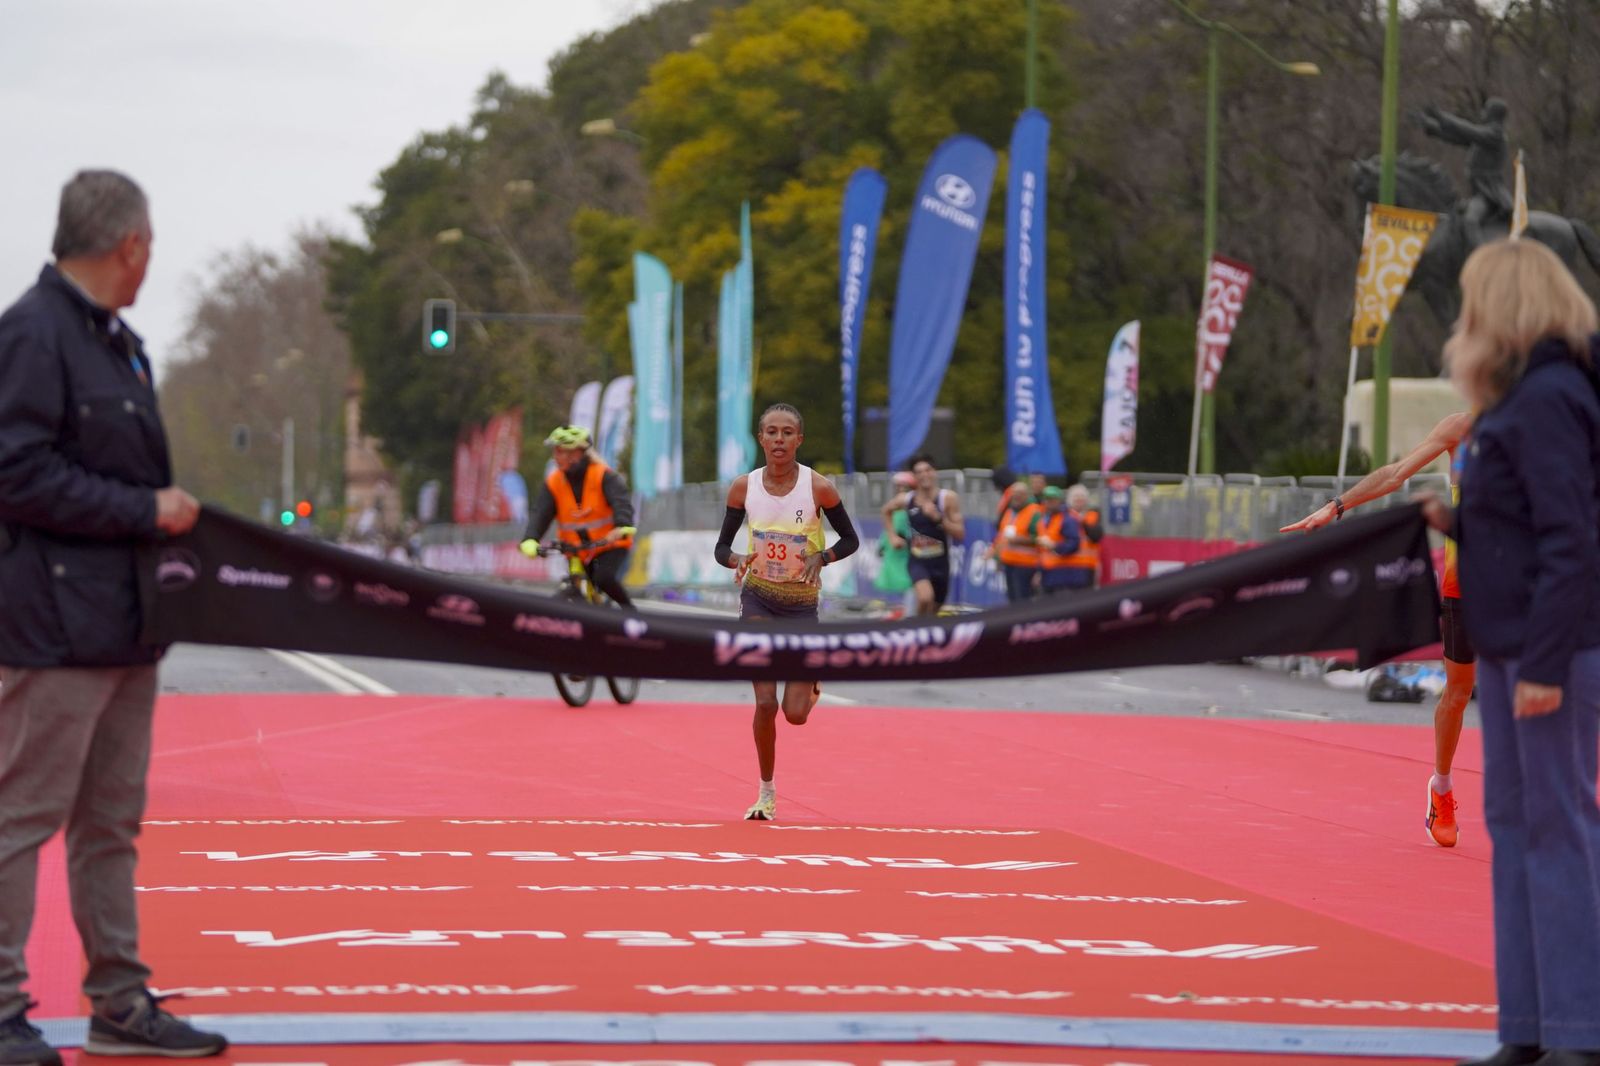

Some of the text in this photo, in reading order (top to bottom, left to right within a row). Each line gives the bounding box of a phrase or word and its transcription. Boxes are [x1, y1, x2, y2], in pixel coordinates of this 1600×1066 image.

[1377, 215, 1434, 233] SEVILLA
[1011, 380, 1035, 447] Run
[767, 542, 787, 561] 33
